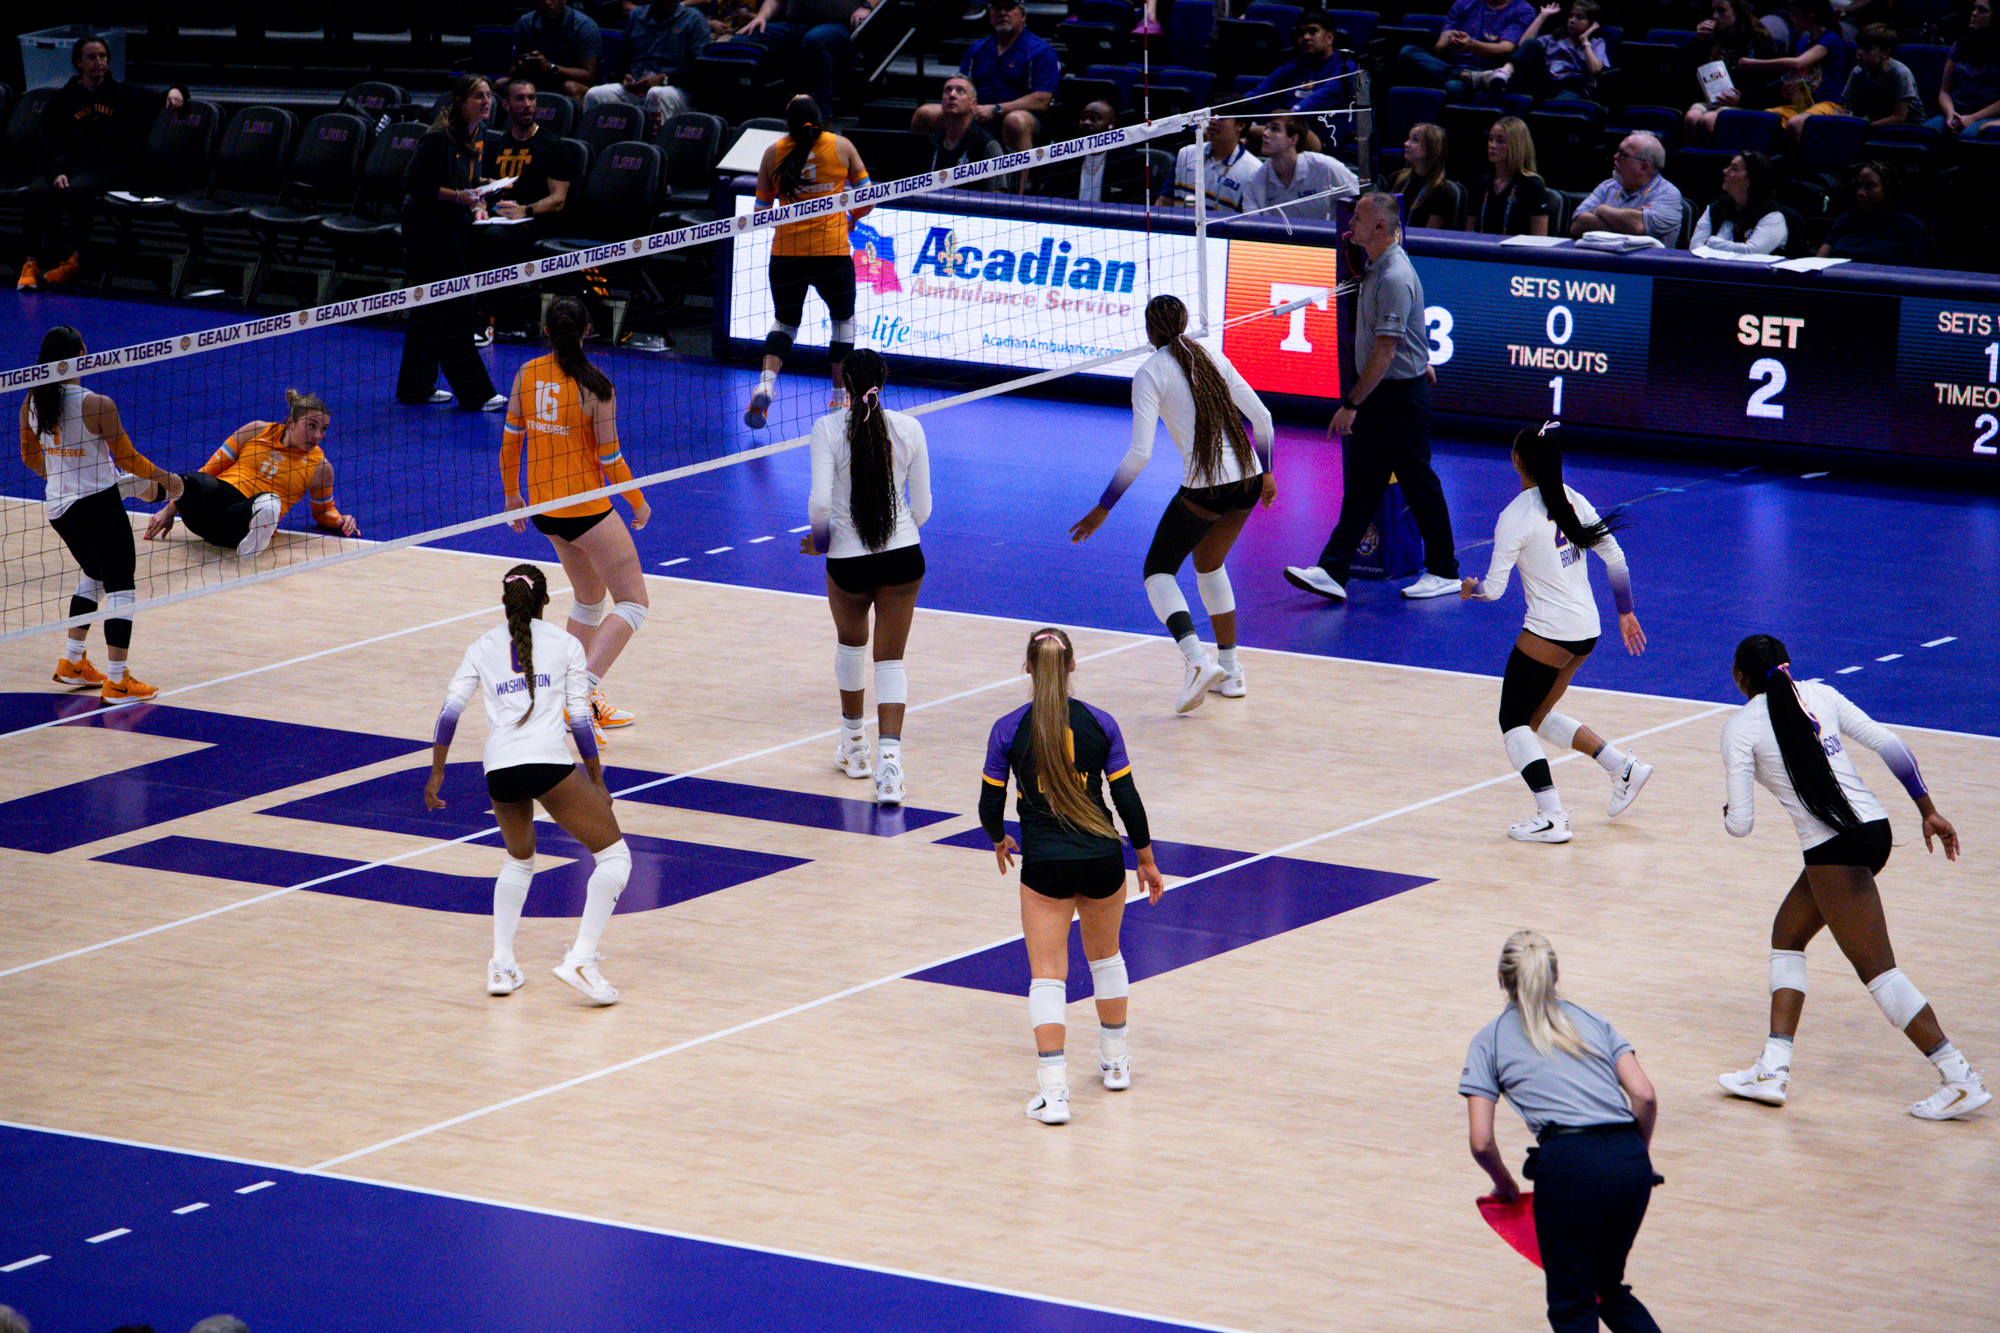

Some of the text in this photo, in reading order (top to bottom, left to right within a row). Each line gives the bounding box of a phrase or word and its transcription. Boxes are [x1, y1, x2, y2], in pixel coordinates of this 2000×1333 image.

[244, 120, 273, 135] LSU
[534, 108, 556, 120] SU
[597, 115, 627, 130] LSU
[319, 127, 348, 142] LSU
[675, 125, 704, 140] LSU
[1050, 129, 1125, 158] GEAUX TIGERS
[612, 155, 642, 170] LSU
[953, 151, 1030, 180] GEAUX TIGERS
[854, 173, 933, 203] GEAUX TIGERS
[1218, 175, 1240, 191] LSU
[753, 196, 834, 227] GEAUX TIGERS
[648, 219, 731, 250] GEAUX TIGERS
[540, 242, 626, 274] GEAUX TIGERS
[912, 226, 1136, 294] Acadian
[429, 266, 518, 299] GEAUX TIGERS
[911, 278, 1131, 317] Ambulance Service
[1510, 275, 1616, 305] SETS WON
[315, 290, 407, 322] GEAUX TIGERS
[1270, 282, 1328, 353] T
[197, 315, 291, 347] GEAUX TIGERS
[871, 314, 910, 348] life
[1546, 305, 1574, 346] 0
[1736, 313, 1805, 349] SET
[1937, 311, 1993, 336] SETS
[76, 340, 172, 372] GEAUX TIGERS
[1506, 344, 1609, 374] TIMEOUTS
[1984, 341, 2000, 383] 1
[0, 364, 50, 387] TIGERS
[1746, 357, 1788, 420] 2
[535, 379, 561, 423] 16
[1547, 375, 1564, 417] 1
[526, 420, 571, 436] TENNESSEE
[1972, 413, 2000, 456] 2
[496, 673, 551, 697] WASHINTON
